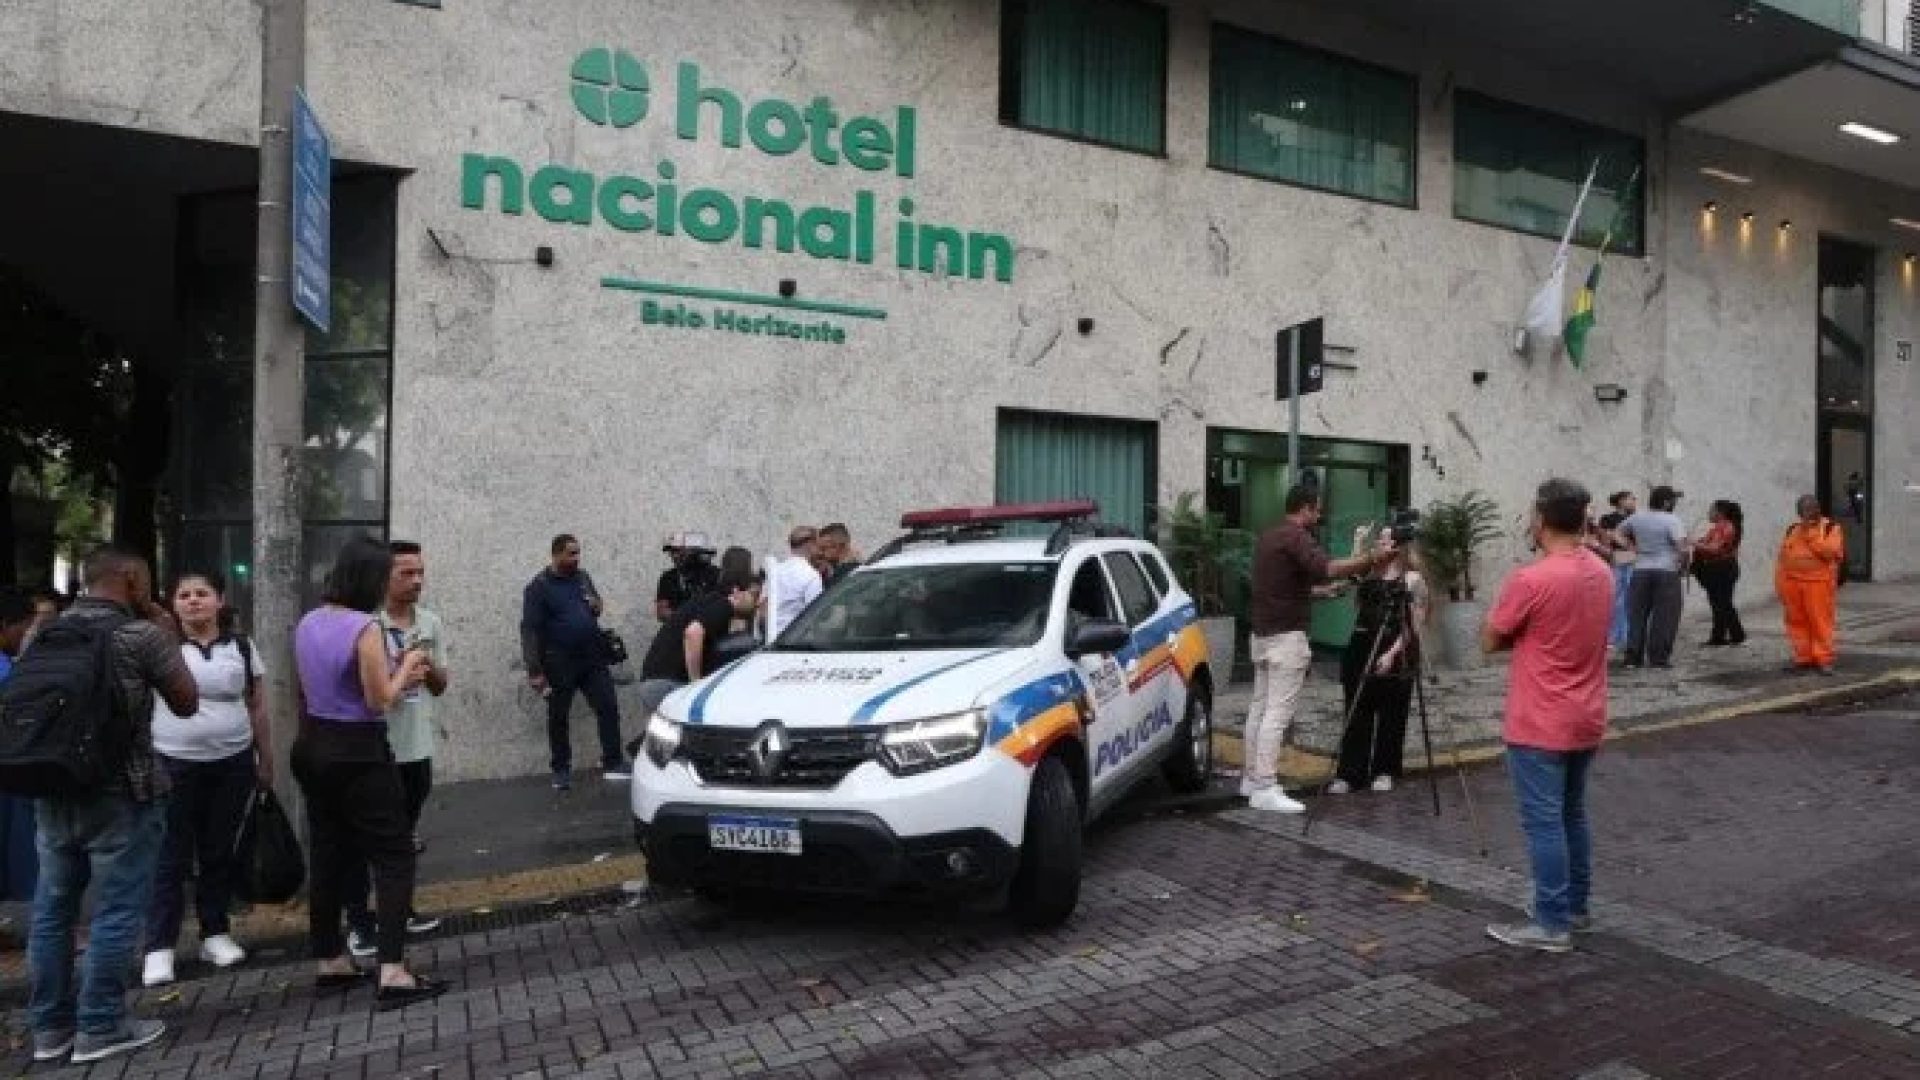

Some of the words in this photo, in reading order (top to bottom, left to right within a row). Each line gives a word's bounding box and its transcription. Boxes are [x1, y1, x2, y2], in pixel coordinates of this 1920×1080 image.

[677, 61, 915, 179] hotel
[461, 152, 874, 264] nacional
[896, 198, 1013, 283] inn
[642, 300, 705, 328] Belo
[714, 308, 845, 344] Horizonte
